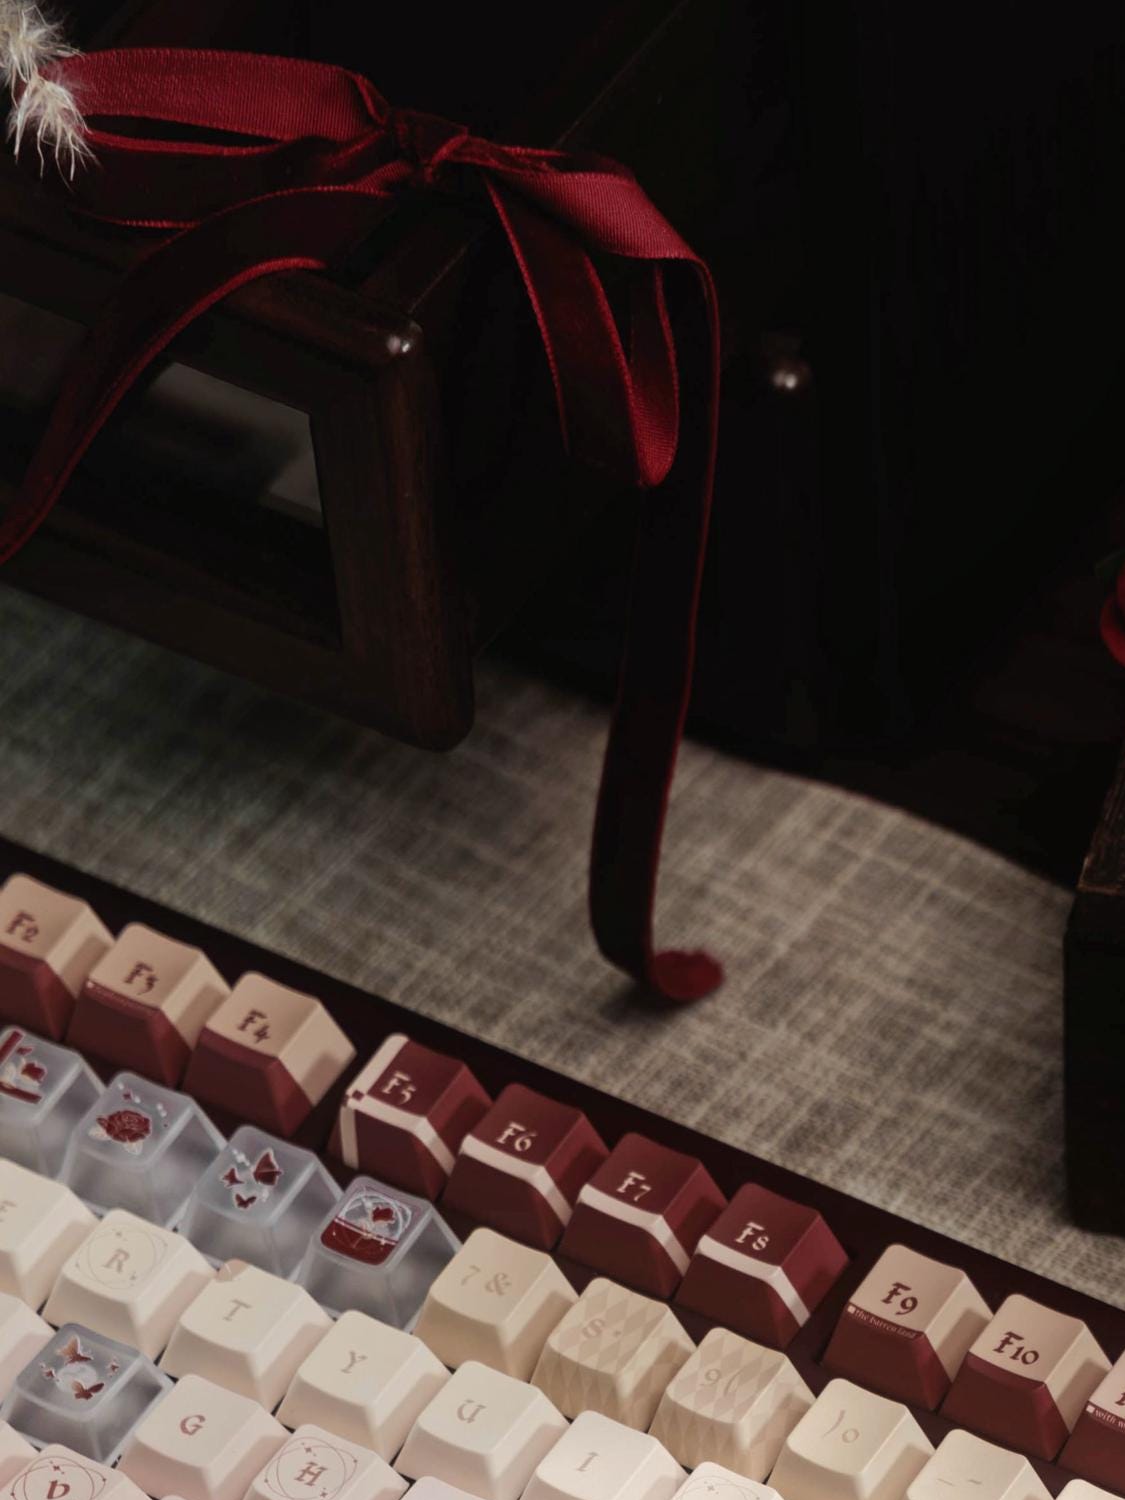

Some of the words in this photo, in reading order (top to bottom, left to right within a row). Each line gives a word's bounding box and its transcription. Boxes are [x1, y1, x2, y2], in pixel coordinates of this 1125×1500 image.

[123, 961, 158, 995] F3
[238, 1009, 271, 1044] F4
[380, 1071, 417, 1104] F5
[496, 1121, 533, 1153] F6
[616, 1171, 652, 1203] F7
[734, 1221, 768, 1252] F8
[101, 1248, 131, 1274] R
[221, 1299, 251, 1321] T
[881, 1281, 918, 1316] F9
[340, 1349, 368, 1375] Y
[992, 1331, 1040, 1365] F10
[179, 1413, 206, 1436] G
[456, 1399, 487, 1424] U
[293, 1461, 327, 1488] H
[576, 1450, 600, 1473] I
